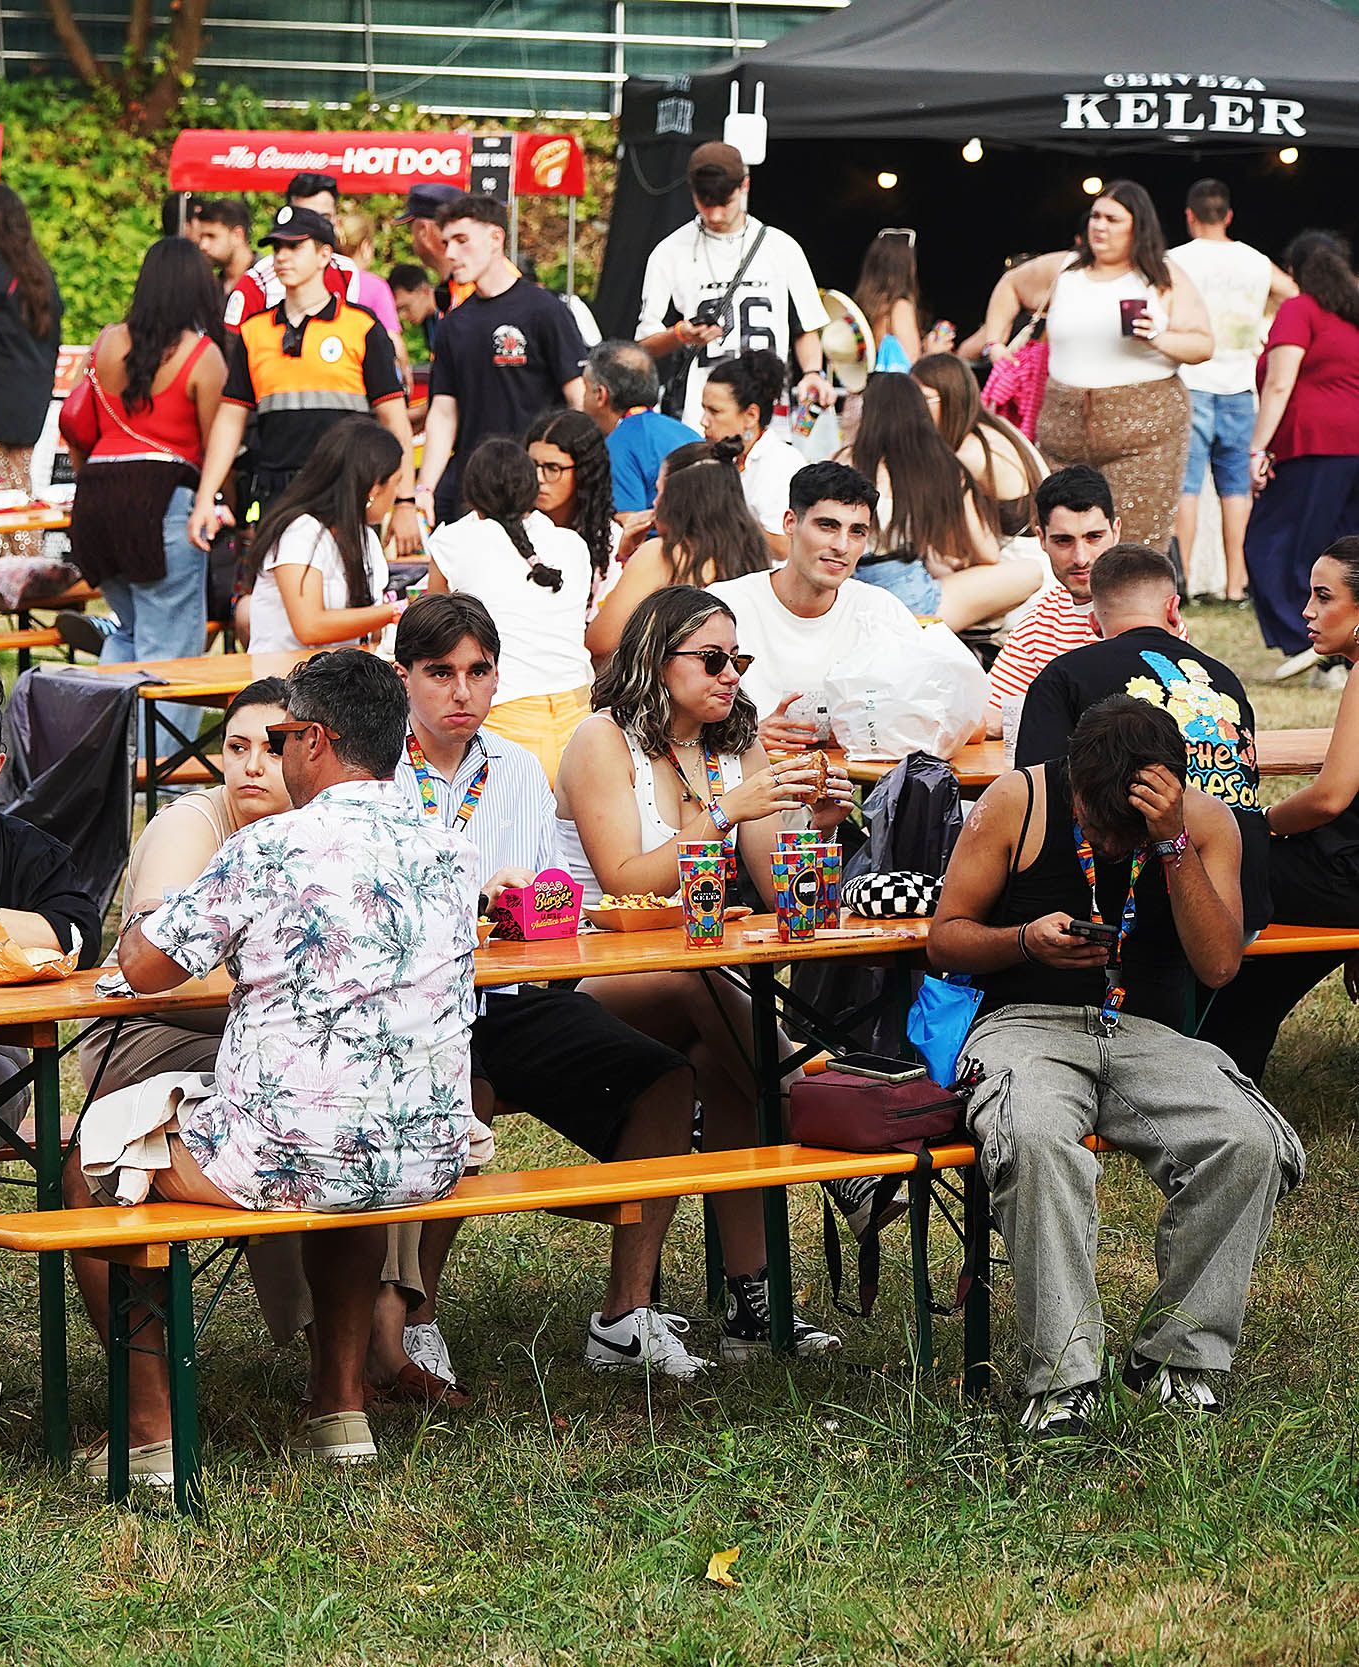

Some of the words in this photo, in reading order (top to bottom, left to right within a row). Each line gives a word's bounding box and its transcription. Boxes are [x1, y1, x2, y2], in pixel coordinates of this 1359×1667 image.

[1103, 73, 1267, 92] CERVEZA
[1060, 92, 1308, 138] KELER
[224, 145, 257, 169] The
[257, 145, 330, 170] Genuine
[534, 880, 564, 893] ROAD
[534, 885, 574, 911] Burger
